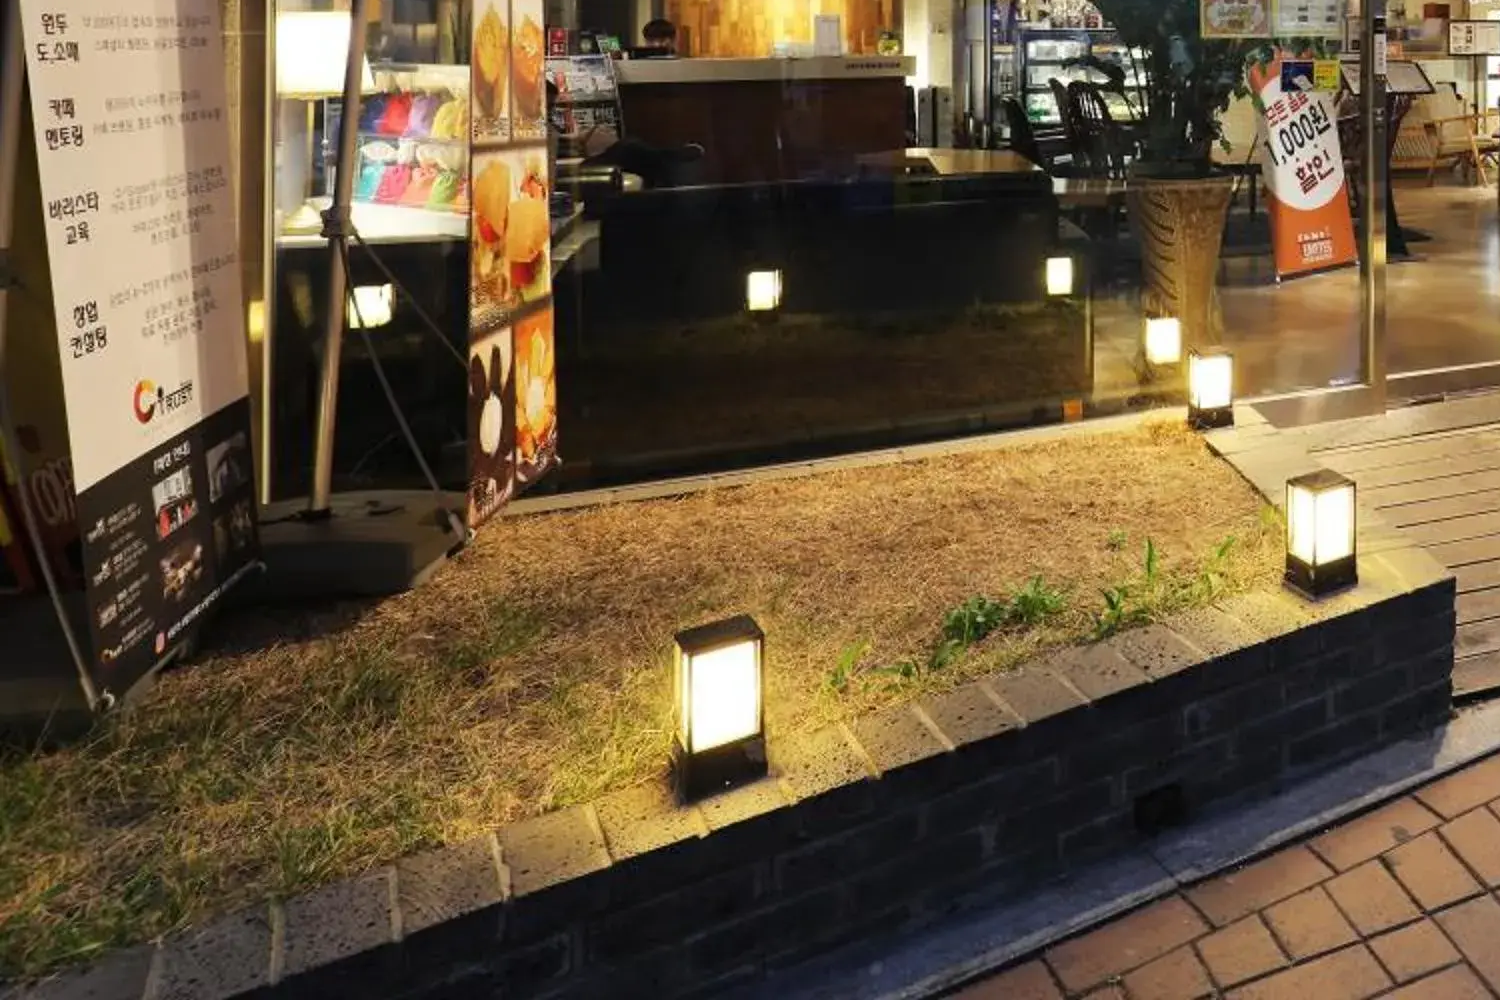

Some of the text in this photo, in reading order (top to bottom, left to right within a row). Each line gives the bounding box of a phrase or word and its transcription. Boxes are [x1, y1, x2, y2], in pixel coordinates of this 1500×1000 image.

[41, 13, 68, 35] 원두
[50, 97, 76, 120] 카페
[45, 125, 84, 151] 멘토링
[1264, 100, 1332, 167] 1,000원
[1296, 149, 1335, 195] 할인
[48, 191, 99, 220] 바리스타
[65, 221, 91, 245] 교육
[73, 300, 99, 329] 창업
[70, 326, 108, 359] 컨설팅
